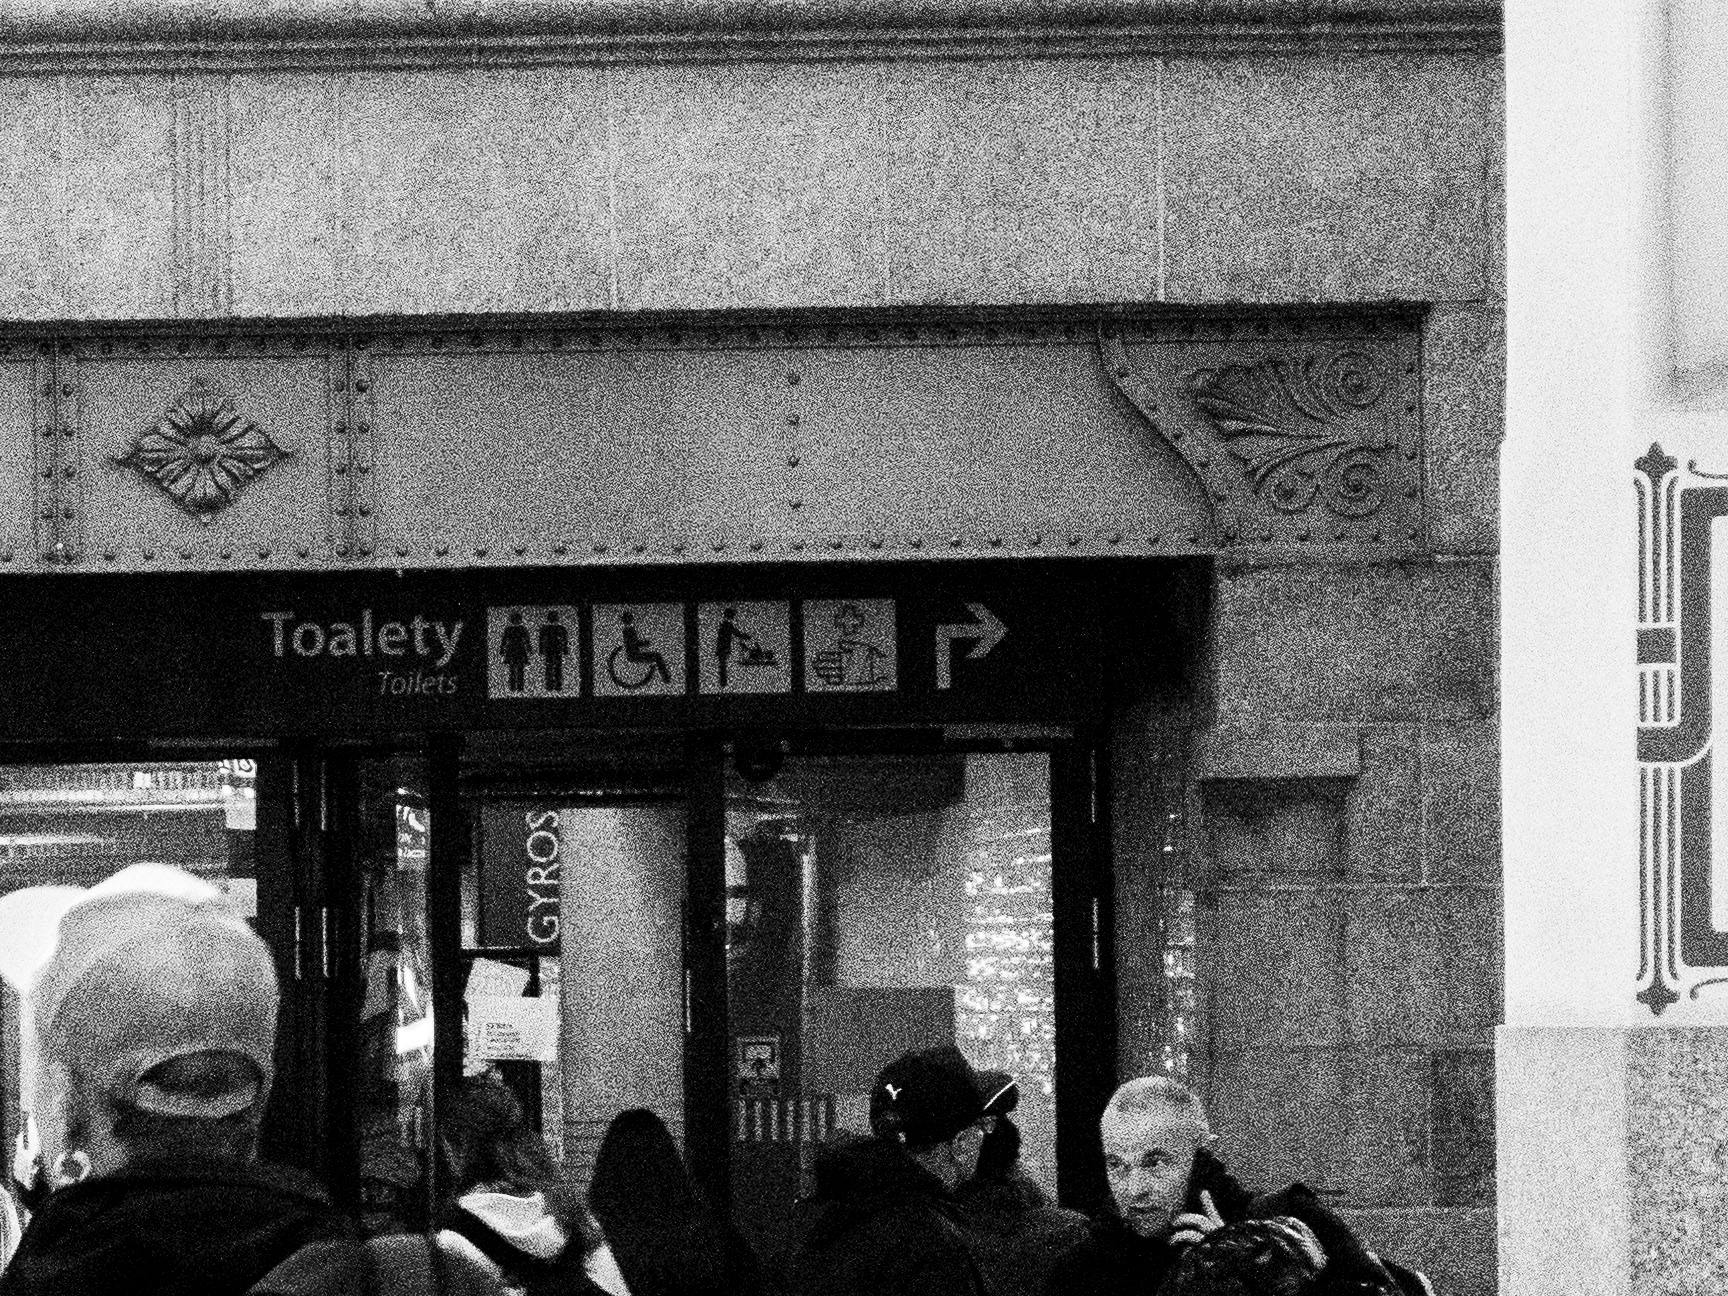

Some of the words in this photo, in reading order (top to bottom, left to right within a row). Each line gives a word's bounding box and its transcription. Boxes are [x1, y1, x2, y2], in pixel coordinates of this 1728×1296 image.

[262, 610, 463, 667] Toalety
[378, 670, 458, 697] Toilets
[525, 809, 560, 943] GYROS
